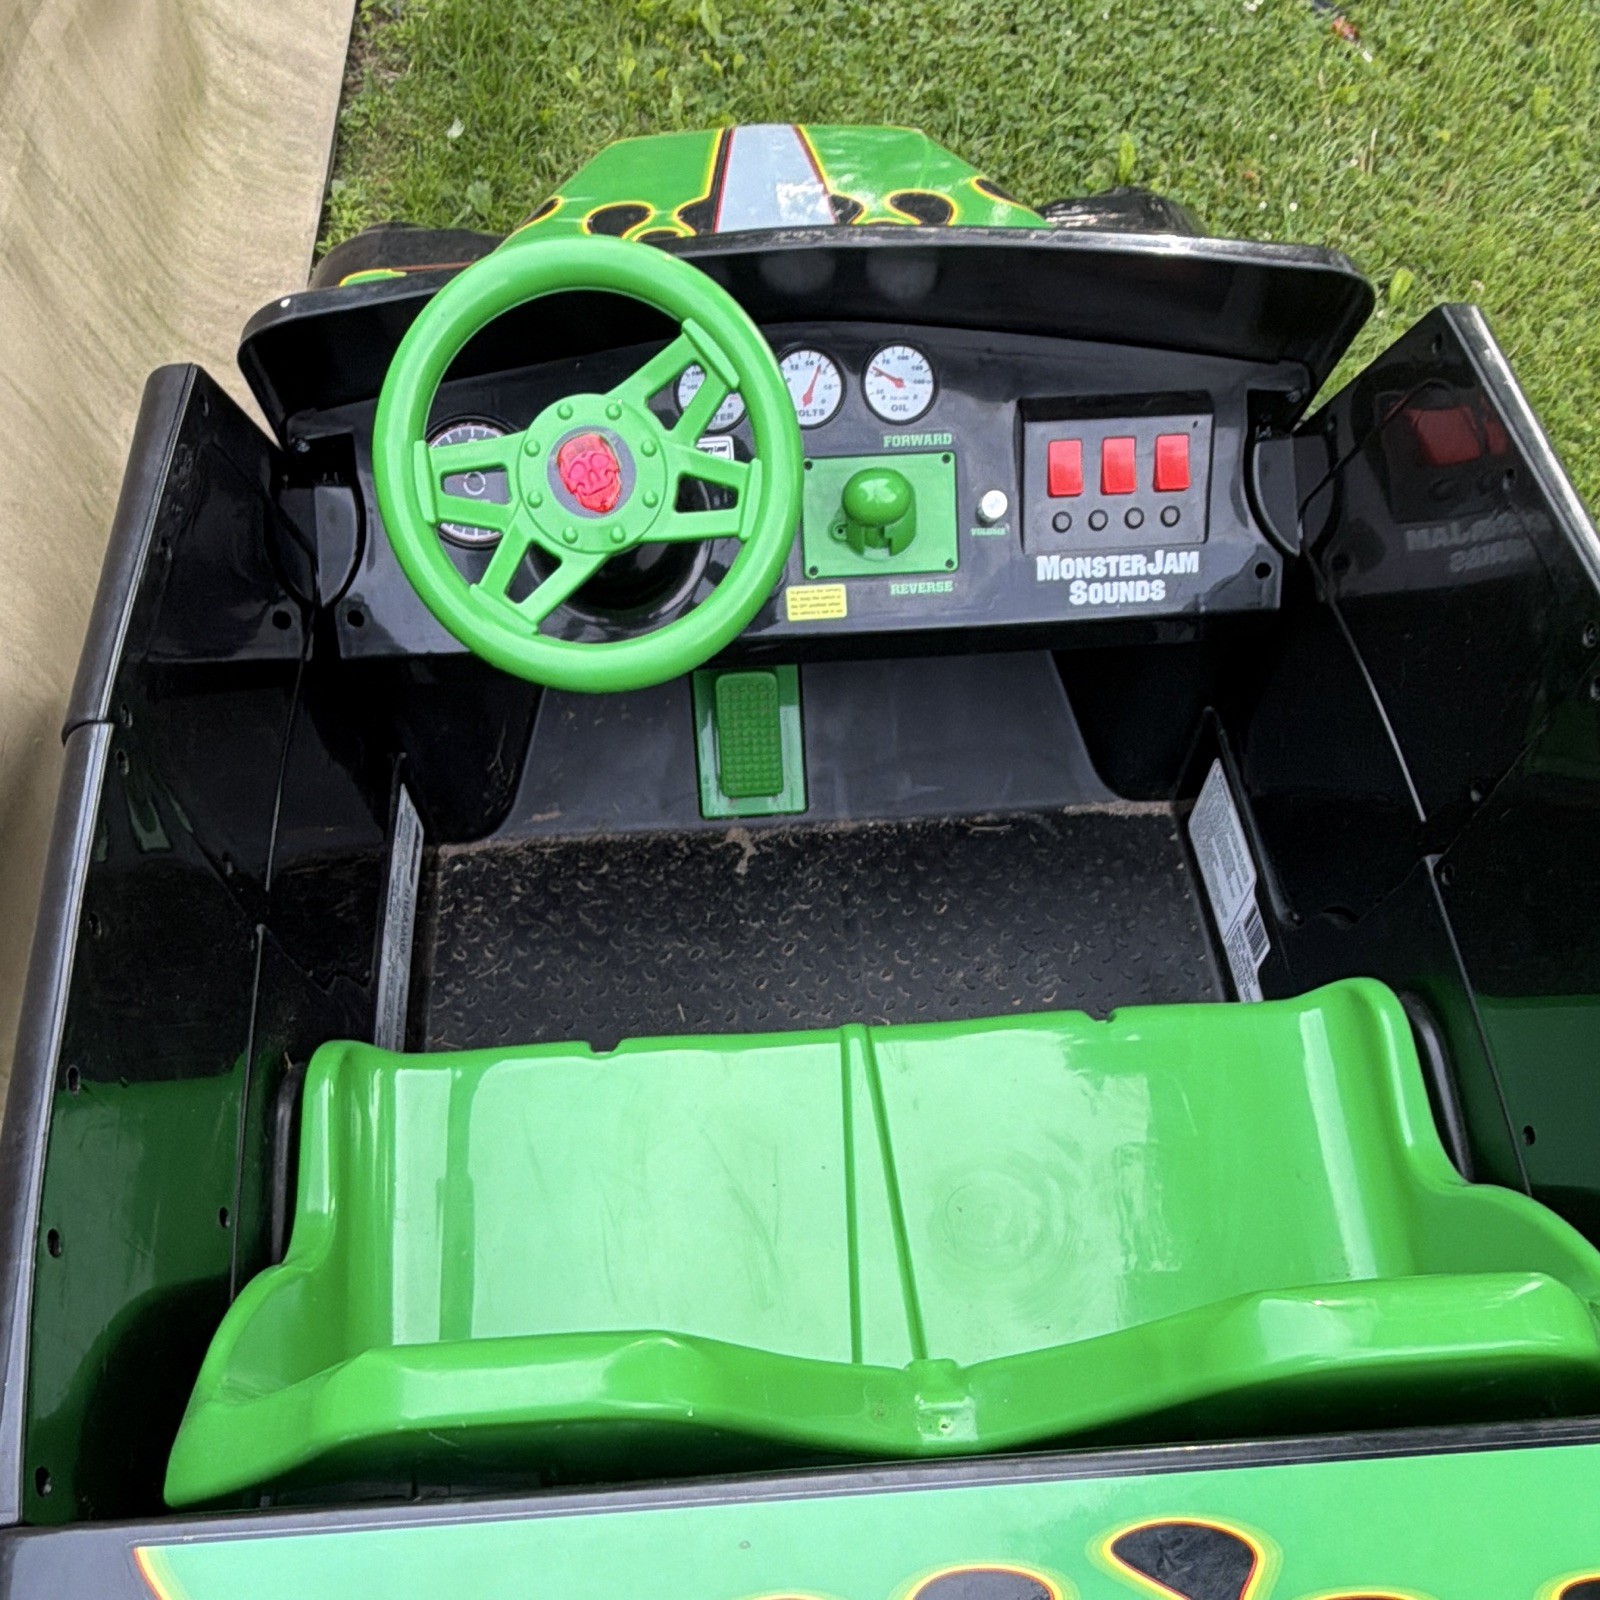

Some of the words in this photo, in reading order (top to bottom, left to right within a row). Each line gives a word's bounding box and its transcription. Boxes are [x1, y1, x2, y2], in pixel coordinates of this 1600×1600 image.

[797, 409, 825, 417] OLTS
[891, 404, 909, 412] OIL
[883, 433, 952, 448] FORWARD
[890, 580, 953, 595] REVERSE
[1069, 579, 1166, 605] SOUNDS
